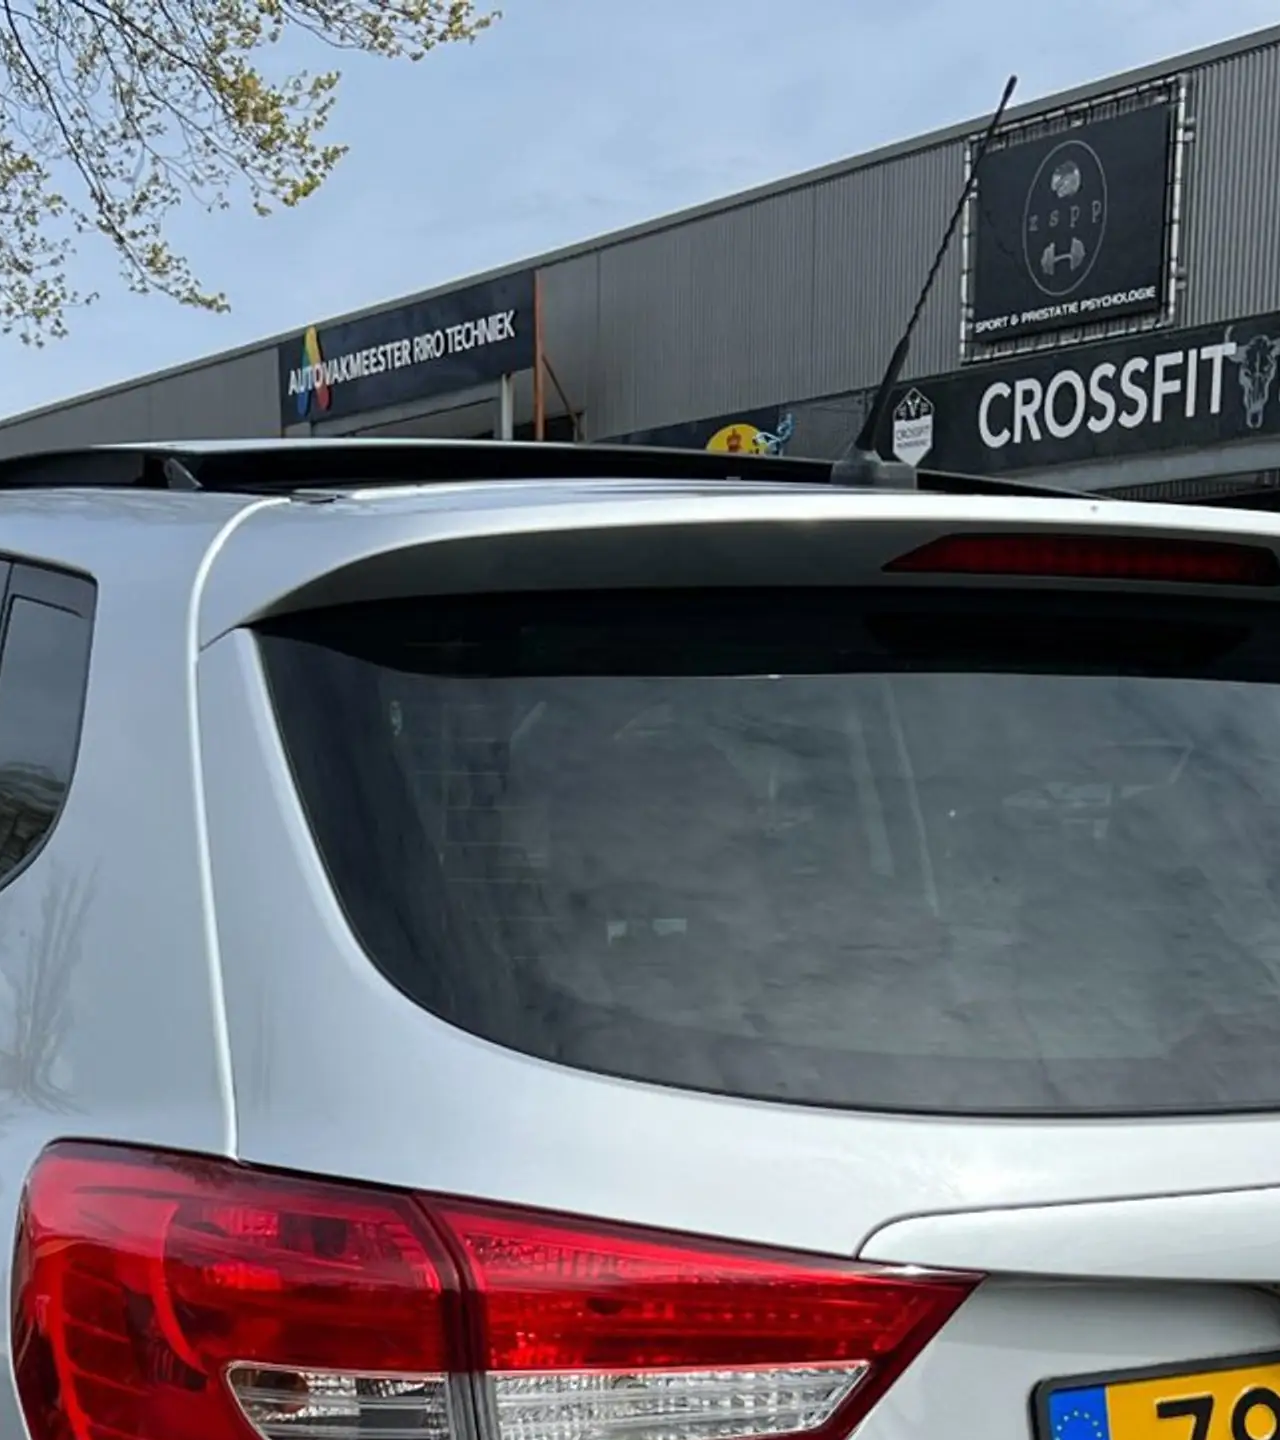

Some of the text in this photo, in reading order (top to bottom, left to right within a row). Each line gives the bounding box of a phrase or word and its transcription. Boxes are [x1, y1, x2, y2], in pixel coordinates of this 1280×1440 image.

[288, 310, 516, 396] AUTOVAKMEESTER RIRO TECHNIEK
[975, 286, 1156, 334] SPORT & PRESTATIE PSYCHOLOGIE
[978, 342, 1237, 449] CROSSFIT
